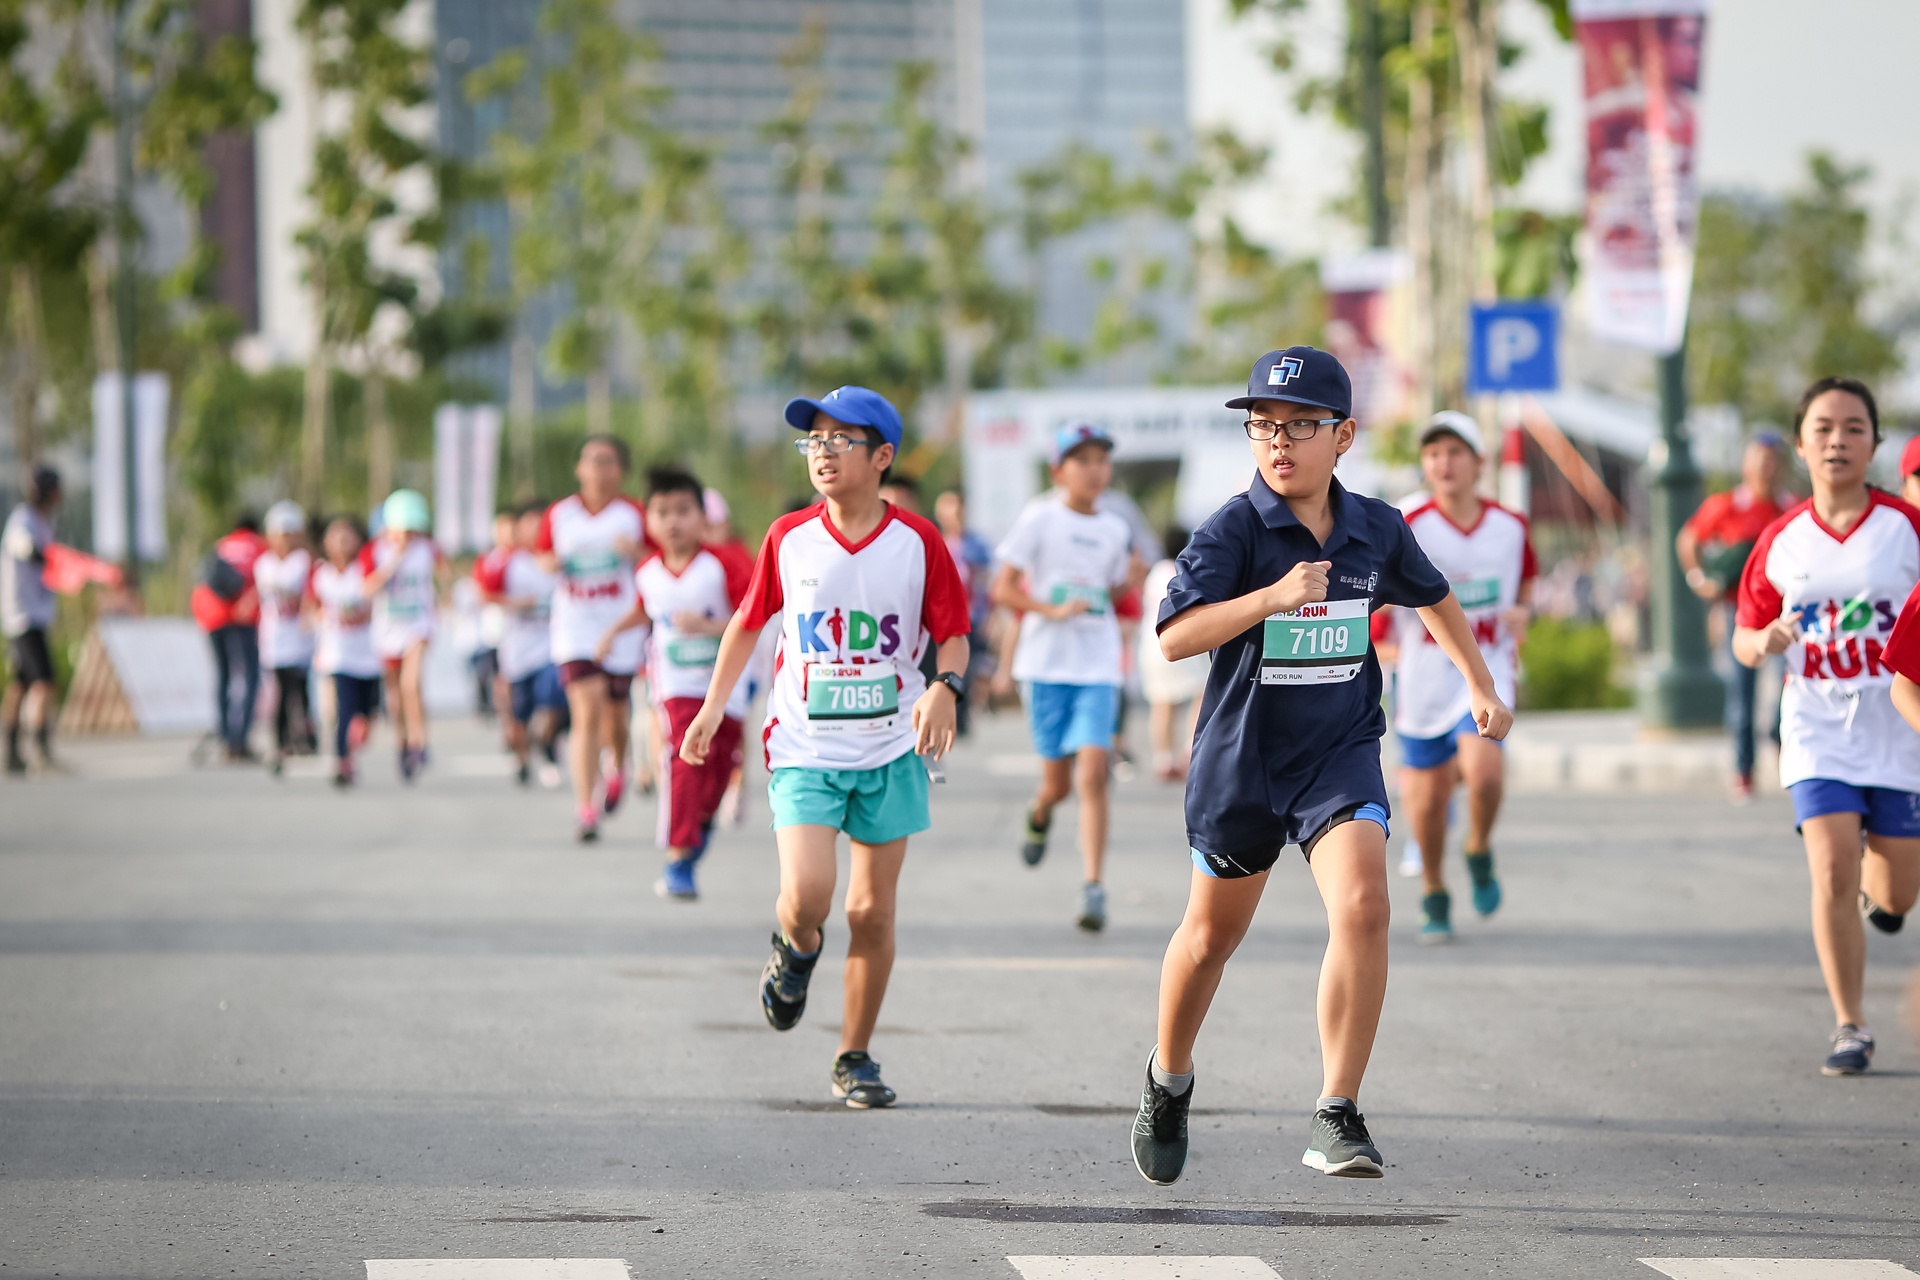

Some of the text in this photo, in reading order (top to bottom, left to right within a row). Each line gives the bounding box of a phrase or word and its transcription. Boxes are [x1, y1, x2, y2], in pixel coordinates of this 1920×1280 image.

[1486, 318, 1541, 382] P
[797, 607, 901, 659] KIDS
[1289, 625, 1349, 655] 7109
[827, 684, 884, 711] 7056
